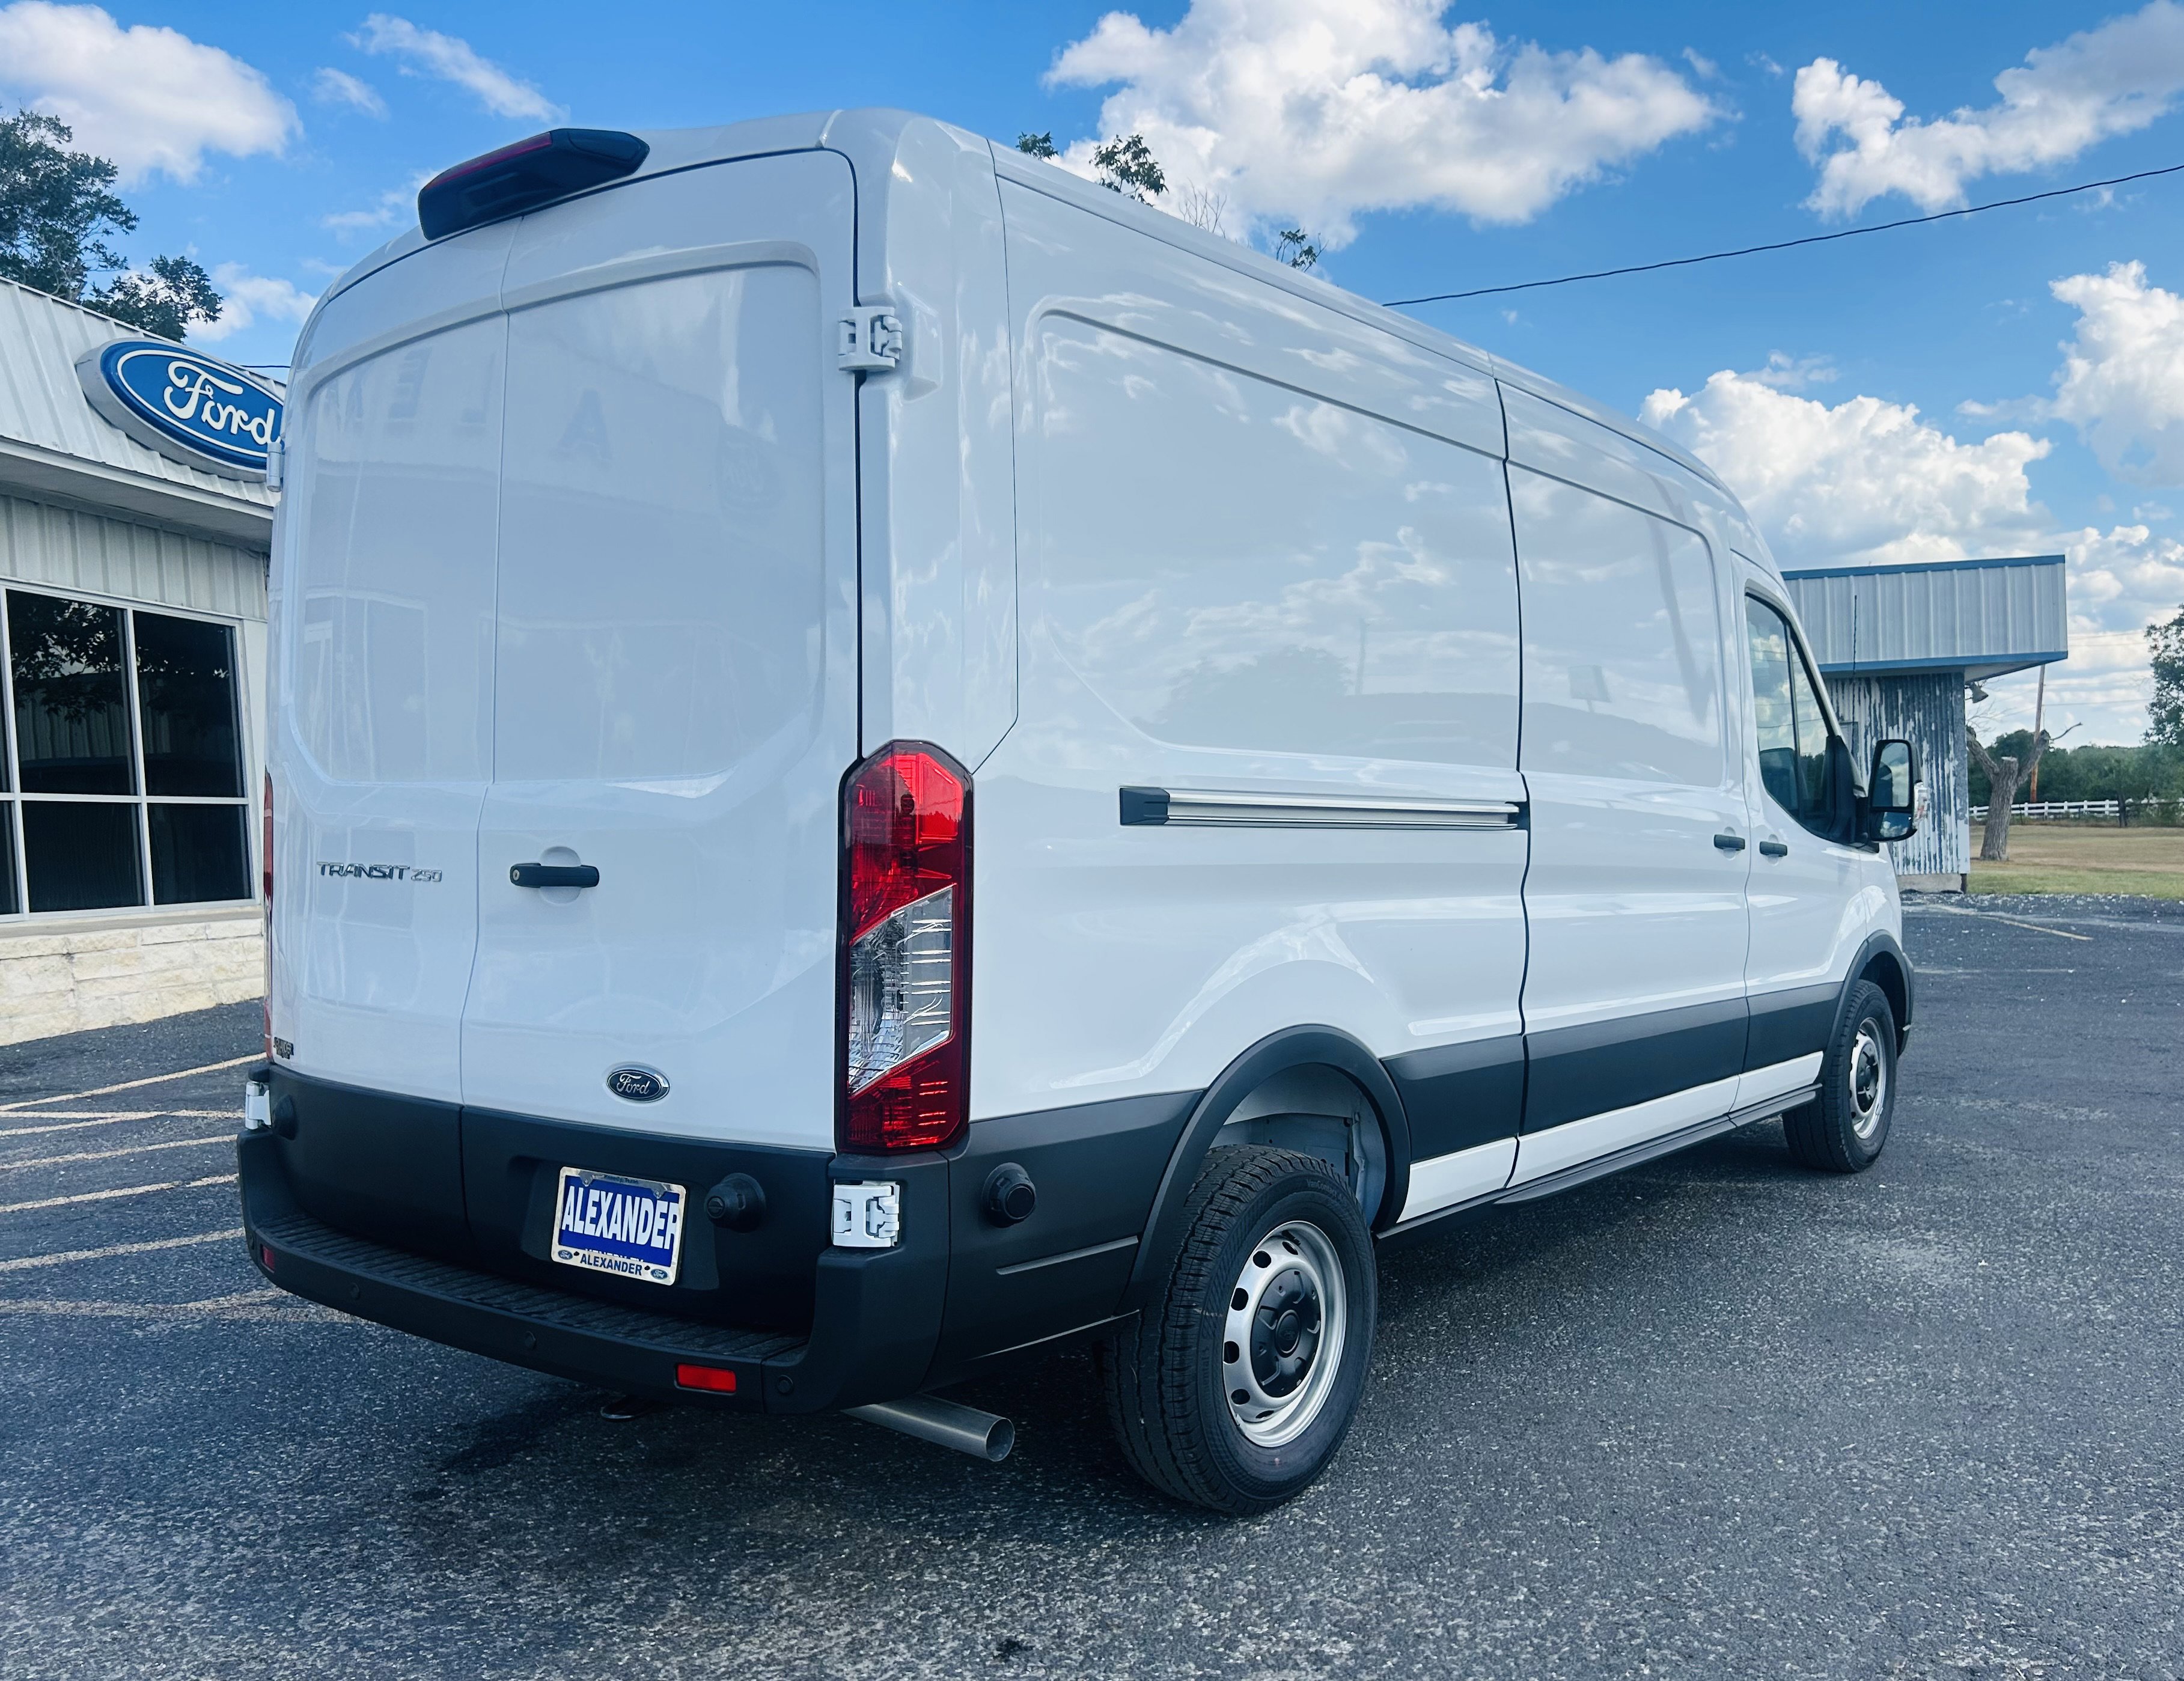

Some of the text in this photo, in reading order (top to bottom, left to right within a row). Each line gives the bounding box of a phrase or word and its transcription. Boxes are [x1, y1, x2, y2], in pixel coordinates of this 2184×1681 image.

[163, 361, 281, 445] Ford
[317, 861, 442, 882] TRANSIT 250
[616, 1073, 650, 1094] Ford
[580, 1253, 642, 1276] ALEXANDER
